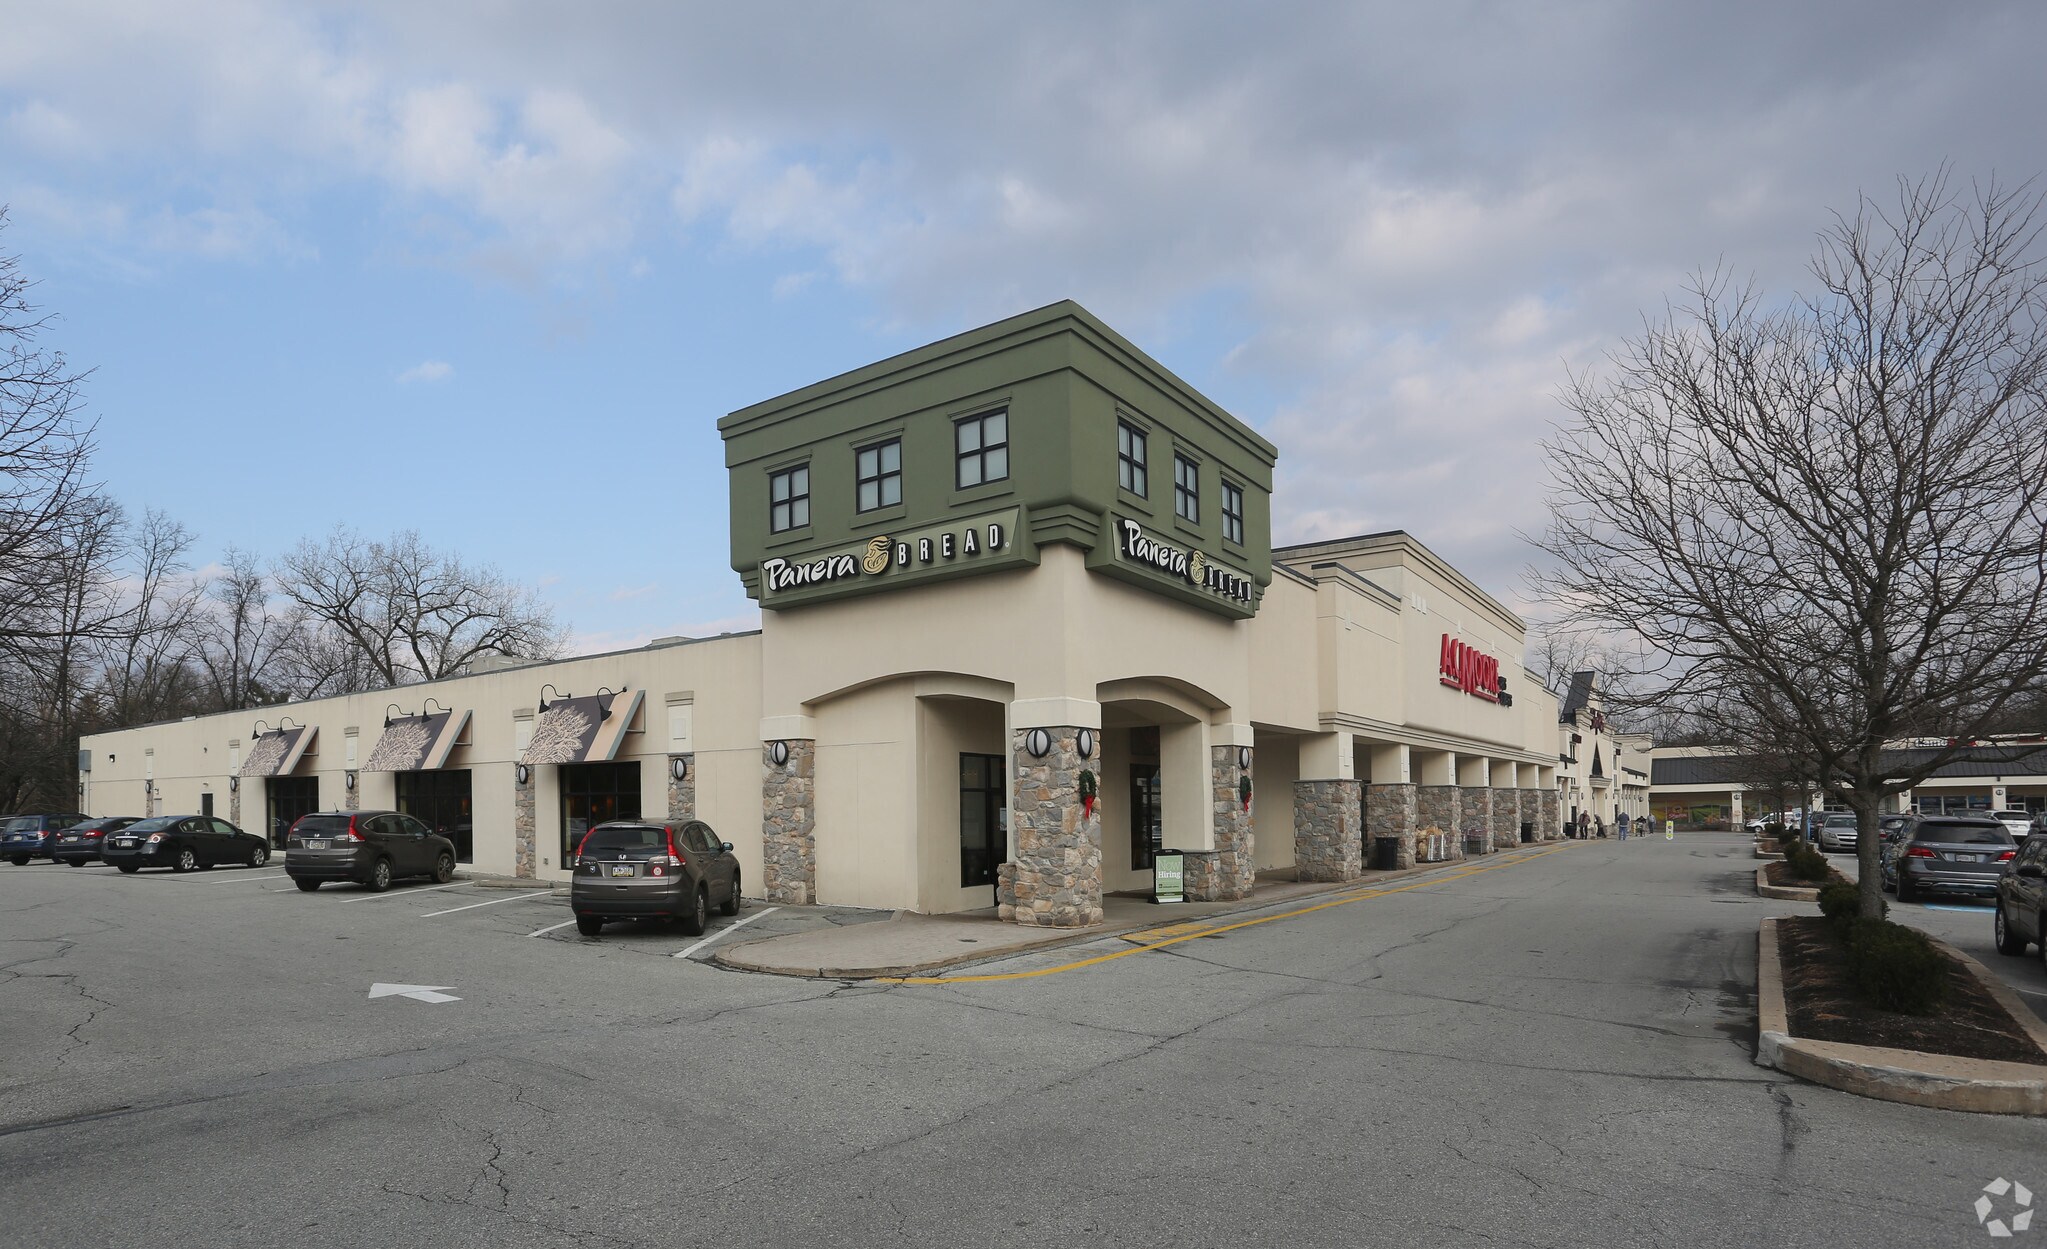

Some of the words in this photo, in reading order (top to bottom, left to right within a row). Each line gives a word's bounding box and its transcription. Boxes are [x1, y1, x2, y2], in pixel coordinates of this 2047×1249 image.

[763, 554, 856, 591] Panera
[897, 524, 1001, 566] BREAD
[1123, 519, 1187, 576] Panera
[1158, 859, 1181, 871] Now
[1158, 870, 1181, 880] Hiring
